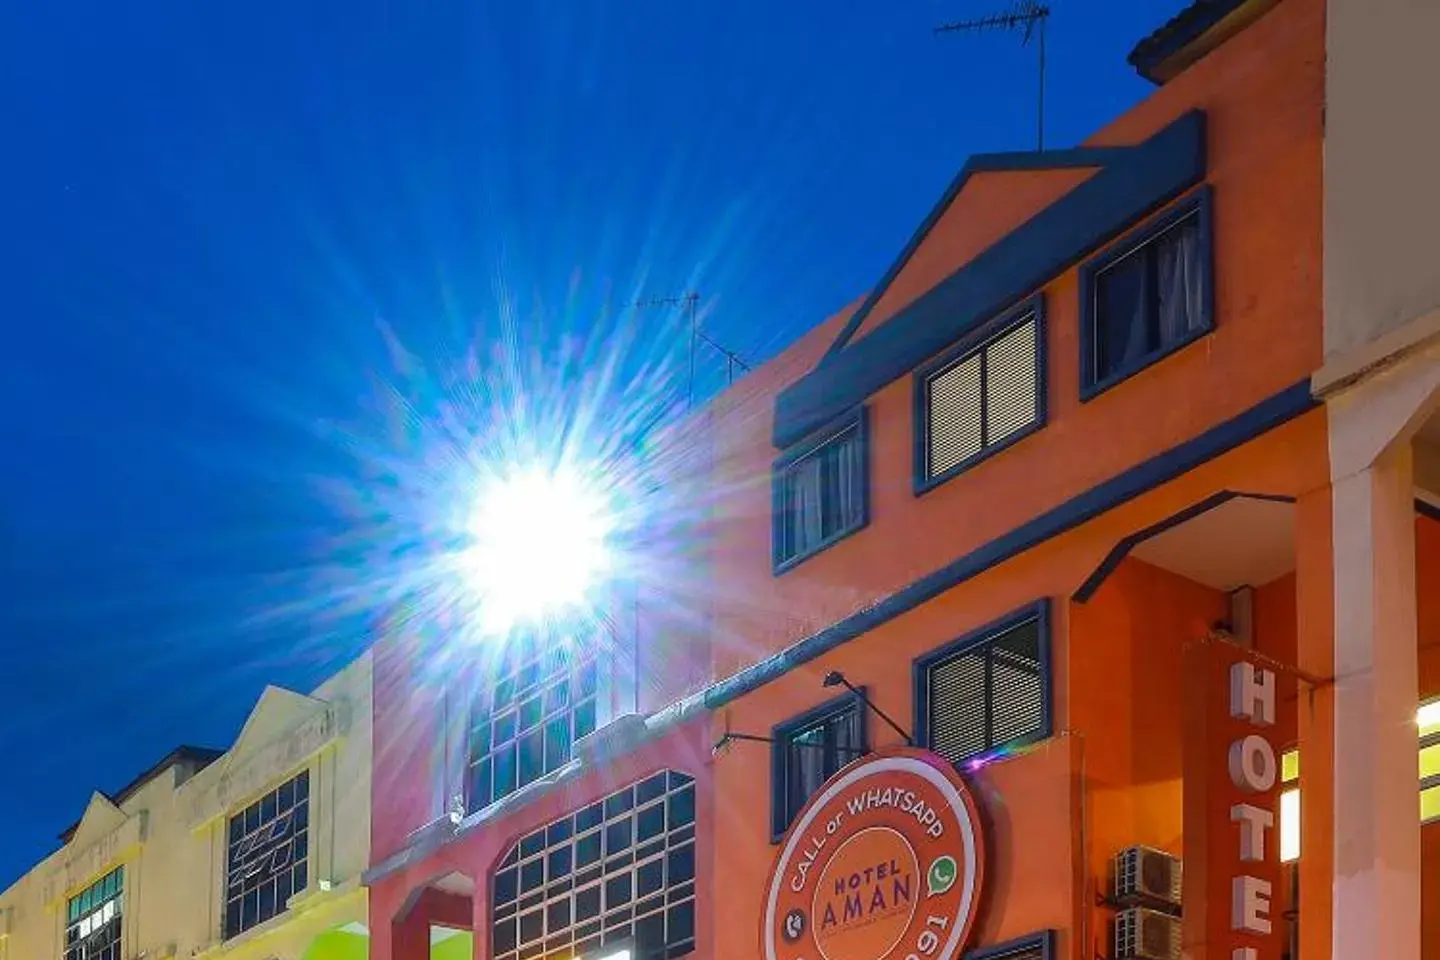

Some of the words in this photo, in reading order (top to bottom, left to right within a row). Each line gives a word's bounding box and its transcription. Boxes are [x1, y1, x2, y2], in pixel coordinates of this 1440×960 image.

[790, 835, 826, 892] CALL
[826, 811, 845, 835] or
[846, 787, 945, 838] WHATSAPP
[821, 874, 911, 931] AMAN
[834, 859, 900, 895] HOTEL
